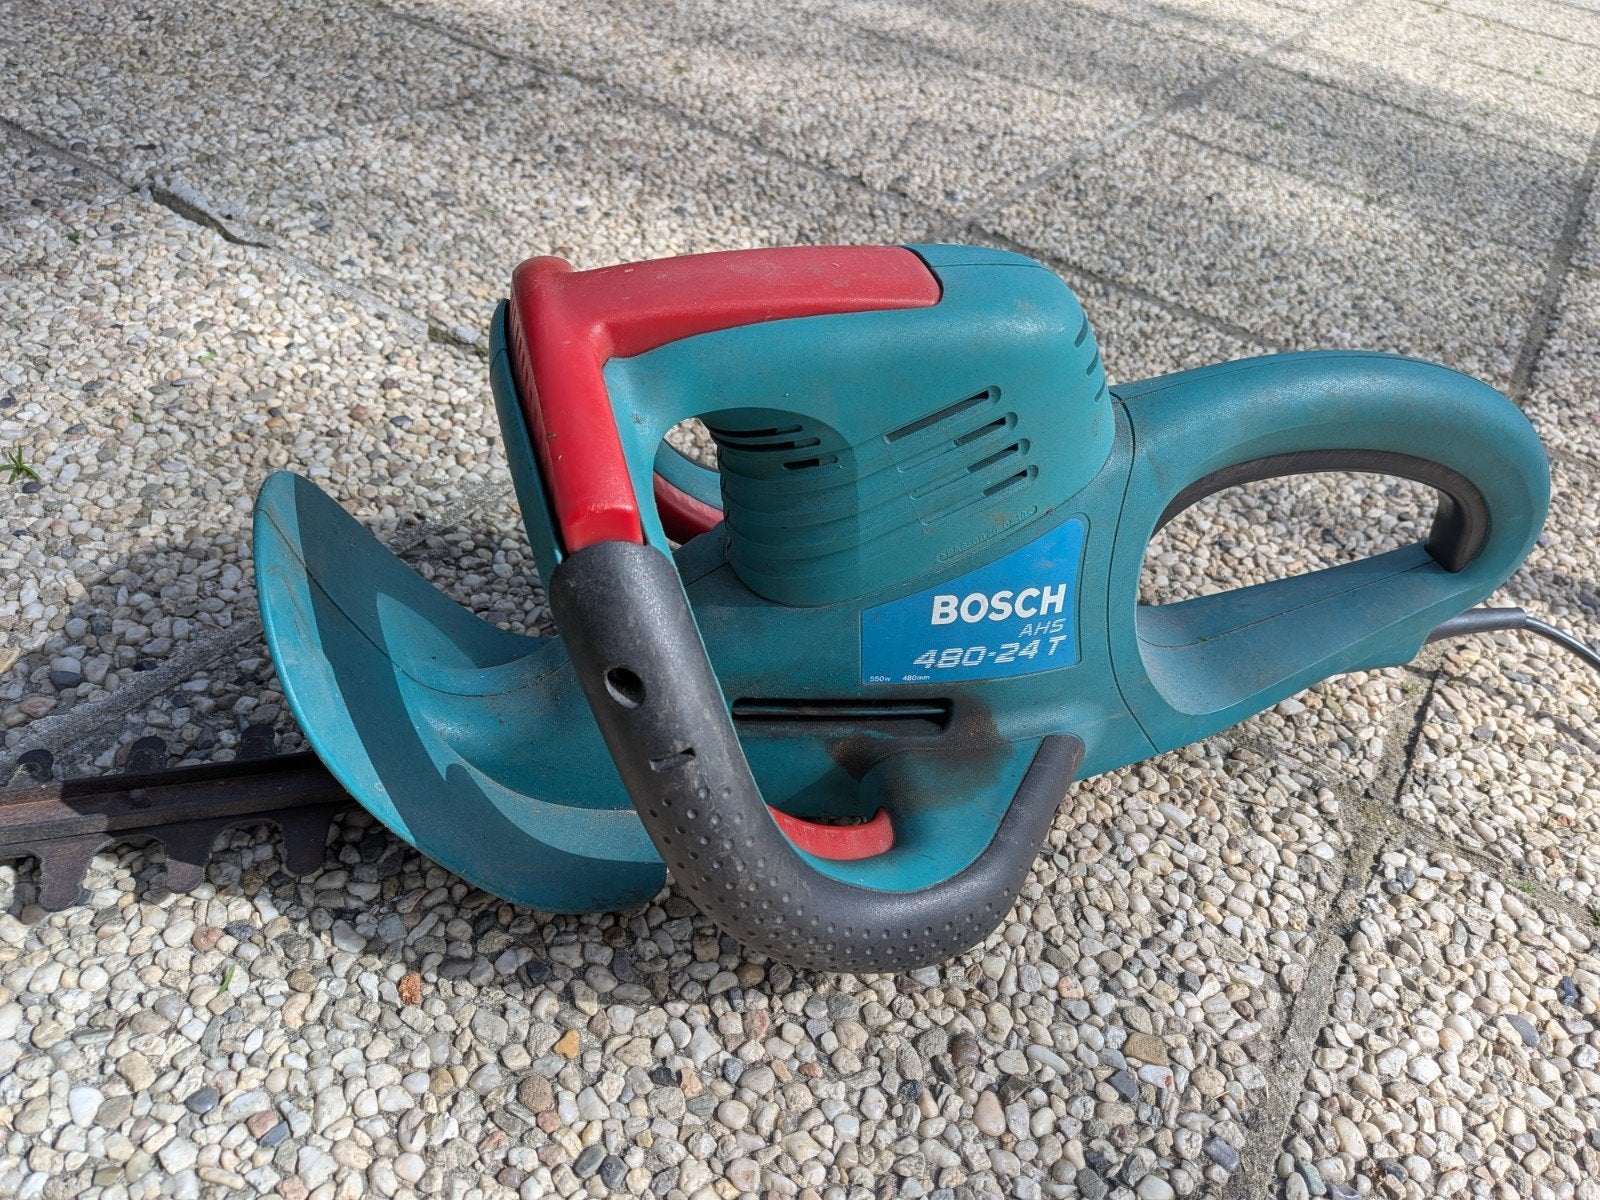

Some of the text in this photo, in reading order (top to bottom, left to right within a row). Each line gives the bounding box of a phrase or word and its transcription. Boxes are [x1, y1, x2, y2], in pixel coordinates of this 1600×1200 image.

[931, 583, 1067, 625] BOSCH
[1018, 618, 1067, 638] AHS
[913, 634, 1067, 669] 480-24 T
